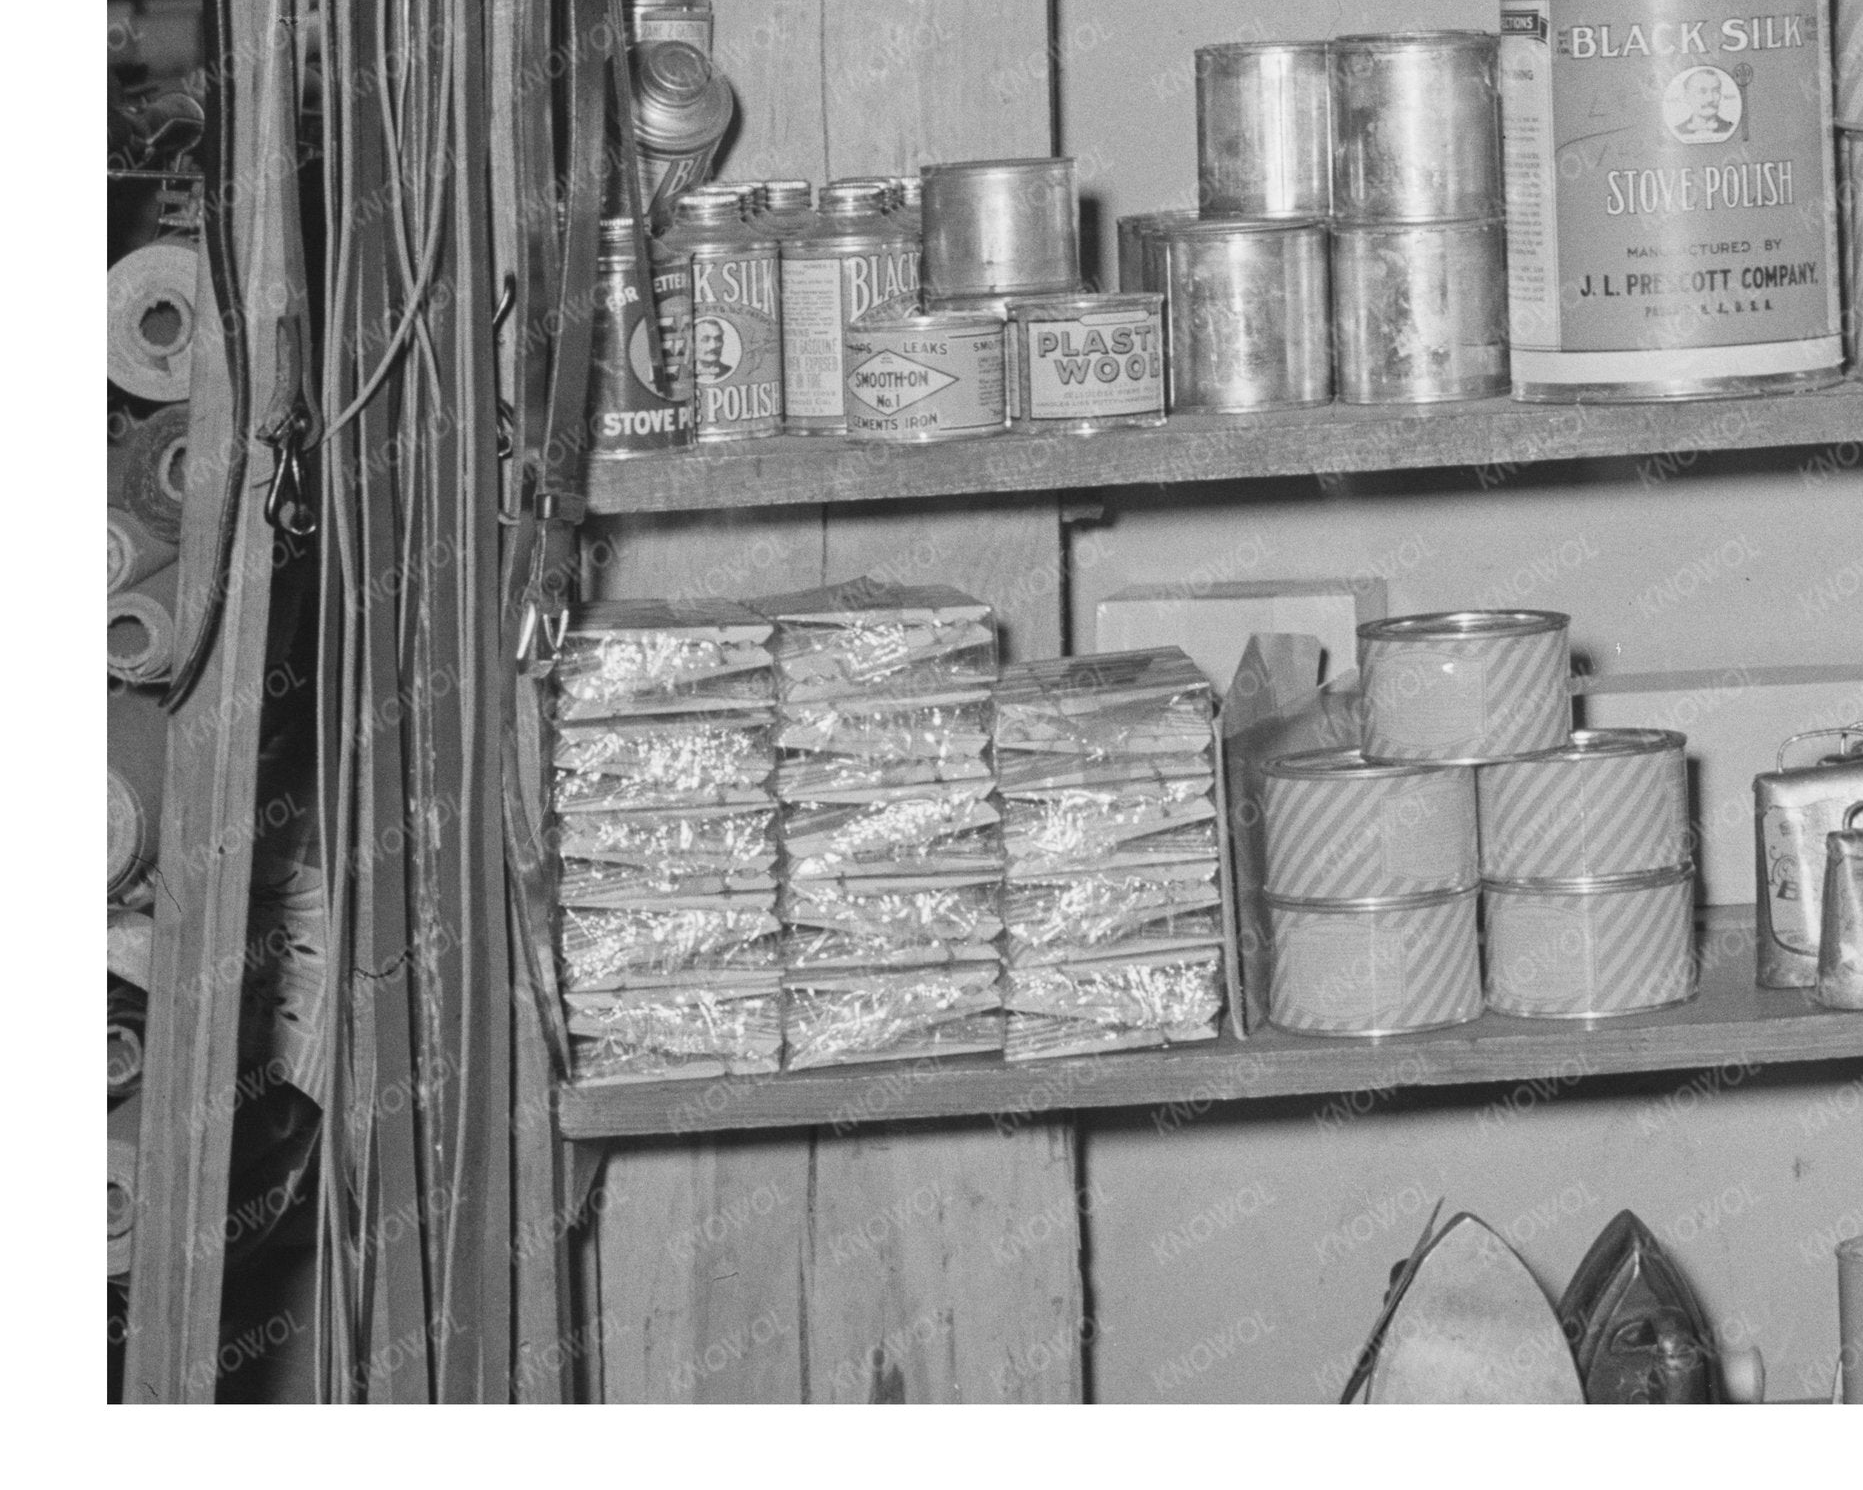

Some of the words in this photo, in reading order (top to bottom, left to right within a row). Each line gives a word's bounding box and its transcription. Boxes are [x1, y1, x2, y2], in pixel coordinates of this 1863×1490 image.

[1570, 21, 1708, 61] BLACK
[1720, 16, 1805, 52] SILK
[1605, 166, 1694, 216] STOVE
[1702, 160, 1794, 210] POLISH
[903, 342, 948, 355] LEAKS
[855, 371, 929, 388] SMOOTH-ON
[603, 409, 675, 437] STOVE
[905, 413, 938, 428] IRON
